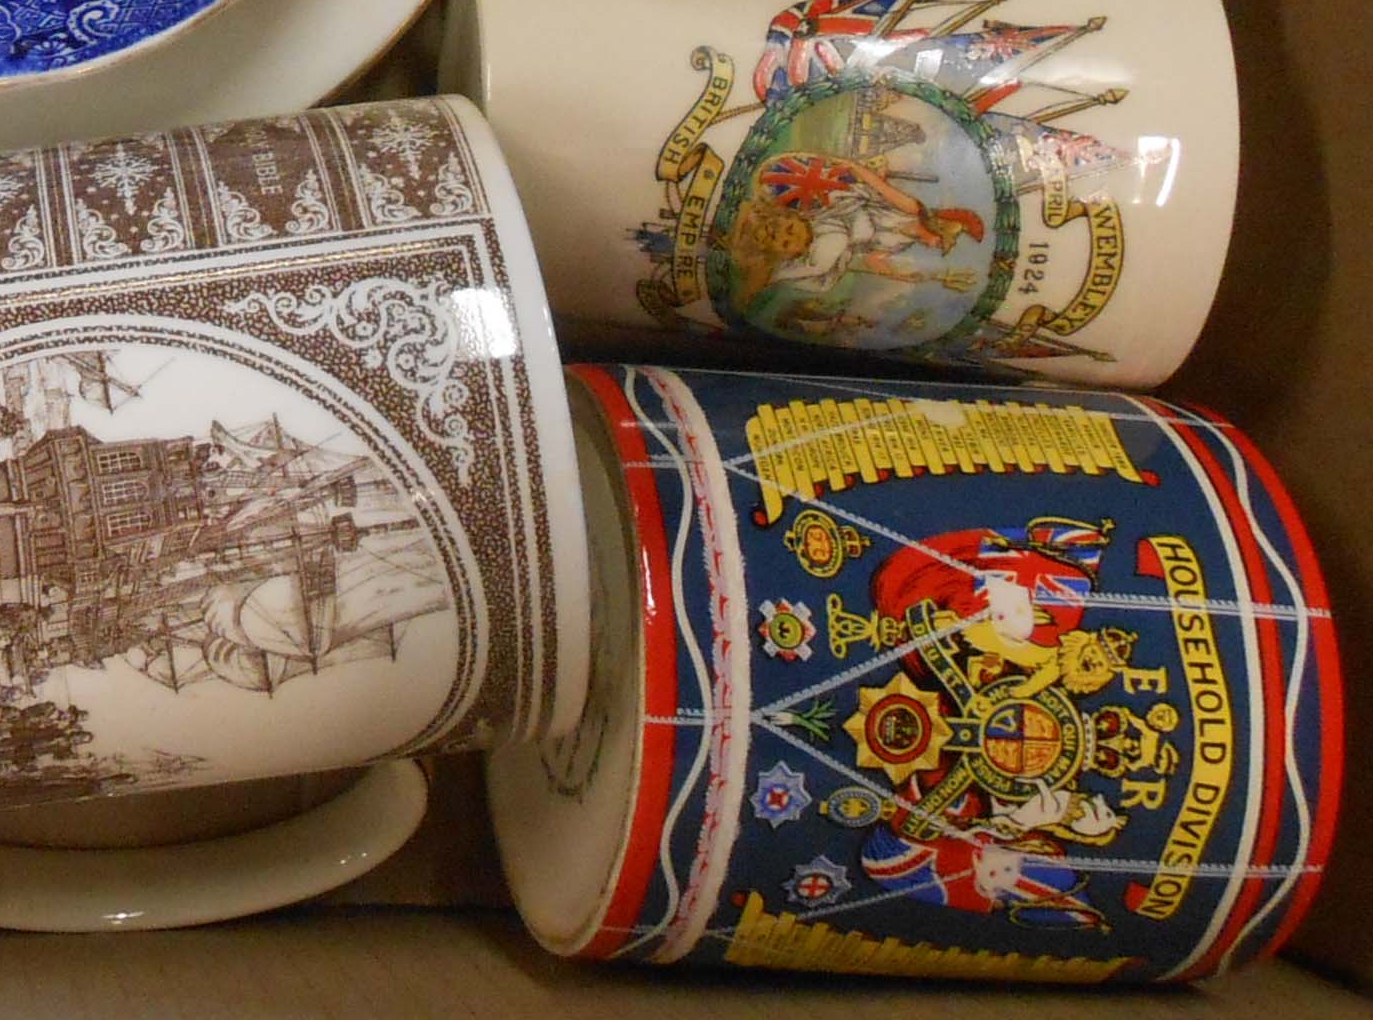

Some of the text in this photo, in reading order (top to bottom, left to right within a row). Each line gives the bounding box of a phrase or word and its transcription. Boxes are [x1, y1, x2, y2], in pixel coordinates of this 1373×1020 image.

[664, 76, 727, 166] BRITISH
[252, 152, 284, 195] BIBLE
[1047, 176, 1065, 223] PRIL
[679, 195, 706, 280] EMPIRE
[1018, 242, 1050, 295] 1924
[1064, 202, 1119, 328] WEMBLEY
[1122, 665, 1169, 695] E
[1062, 720, 1078, 748] QUI
[1140, 541, 1227, 916] HOUSEHOLD DIVISION
[1119, 777, 1168, 811] R
